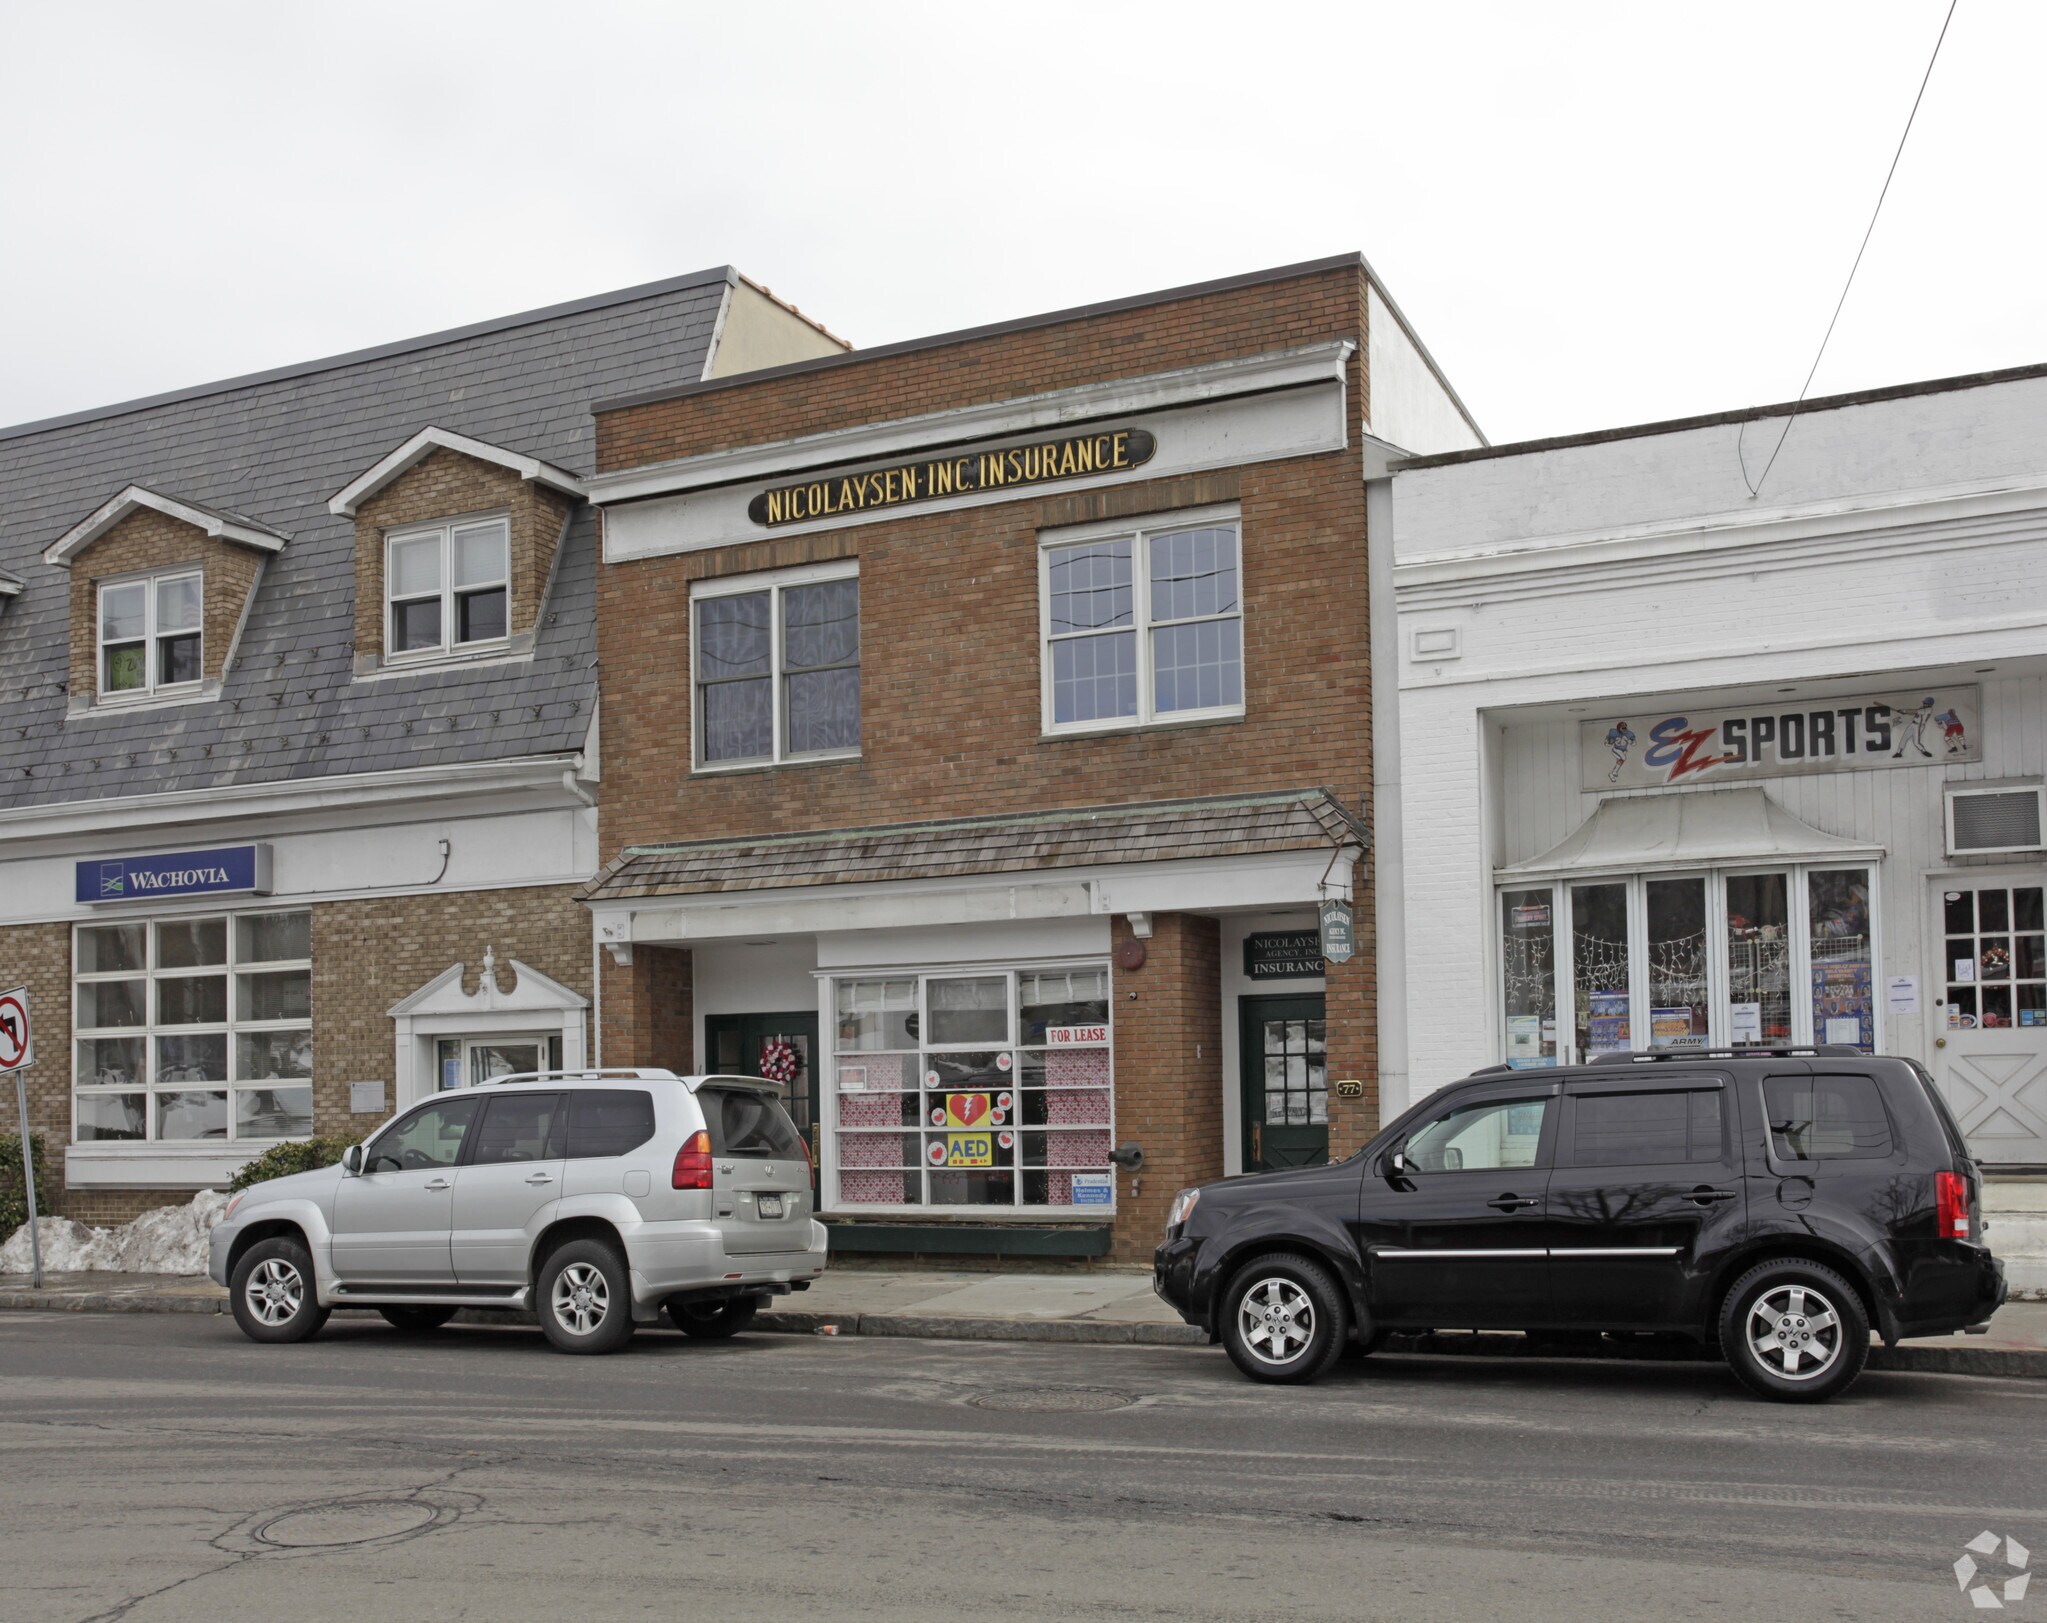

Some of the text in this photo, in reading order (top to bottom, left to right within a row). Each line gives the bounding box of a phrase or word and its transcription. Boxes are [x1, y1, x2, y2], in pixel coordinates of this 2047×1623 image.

[928, 458, 974, 496] INC.
[979, 432, 1130, 487] INSURANCE
[1644, 705, 1892, 783] EZ SPORTS
[129, 867, 230, 890] WACHOVIA
[1323, 911, 1350, 926] NICOLAYSEN
[1326, 944, 1350, 953] INSURANCE
[1051, 1027, 1106, 1042] FOR LEASE
[1671, 1038, 1703, 1046] ARMY
[1343, 1084, 1356, 1094] 77
[949, 1139, 989, 1157] AED
